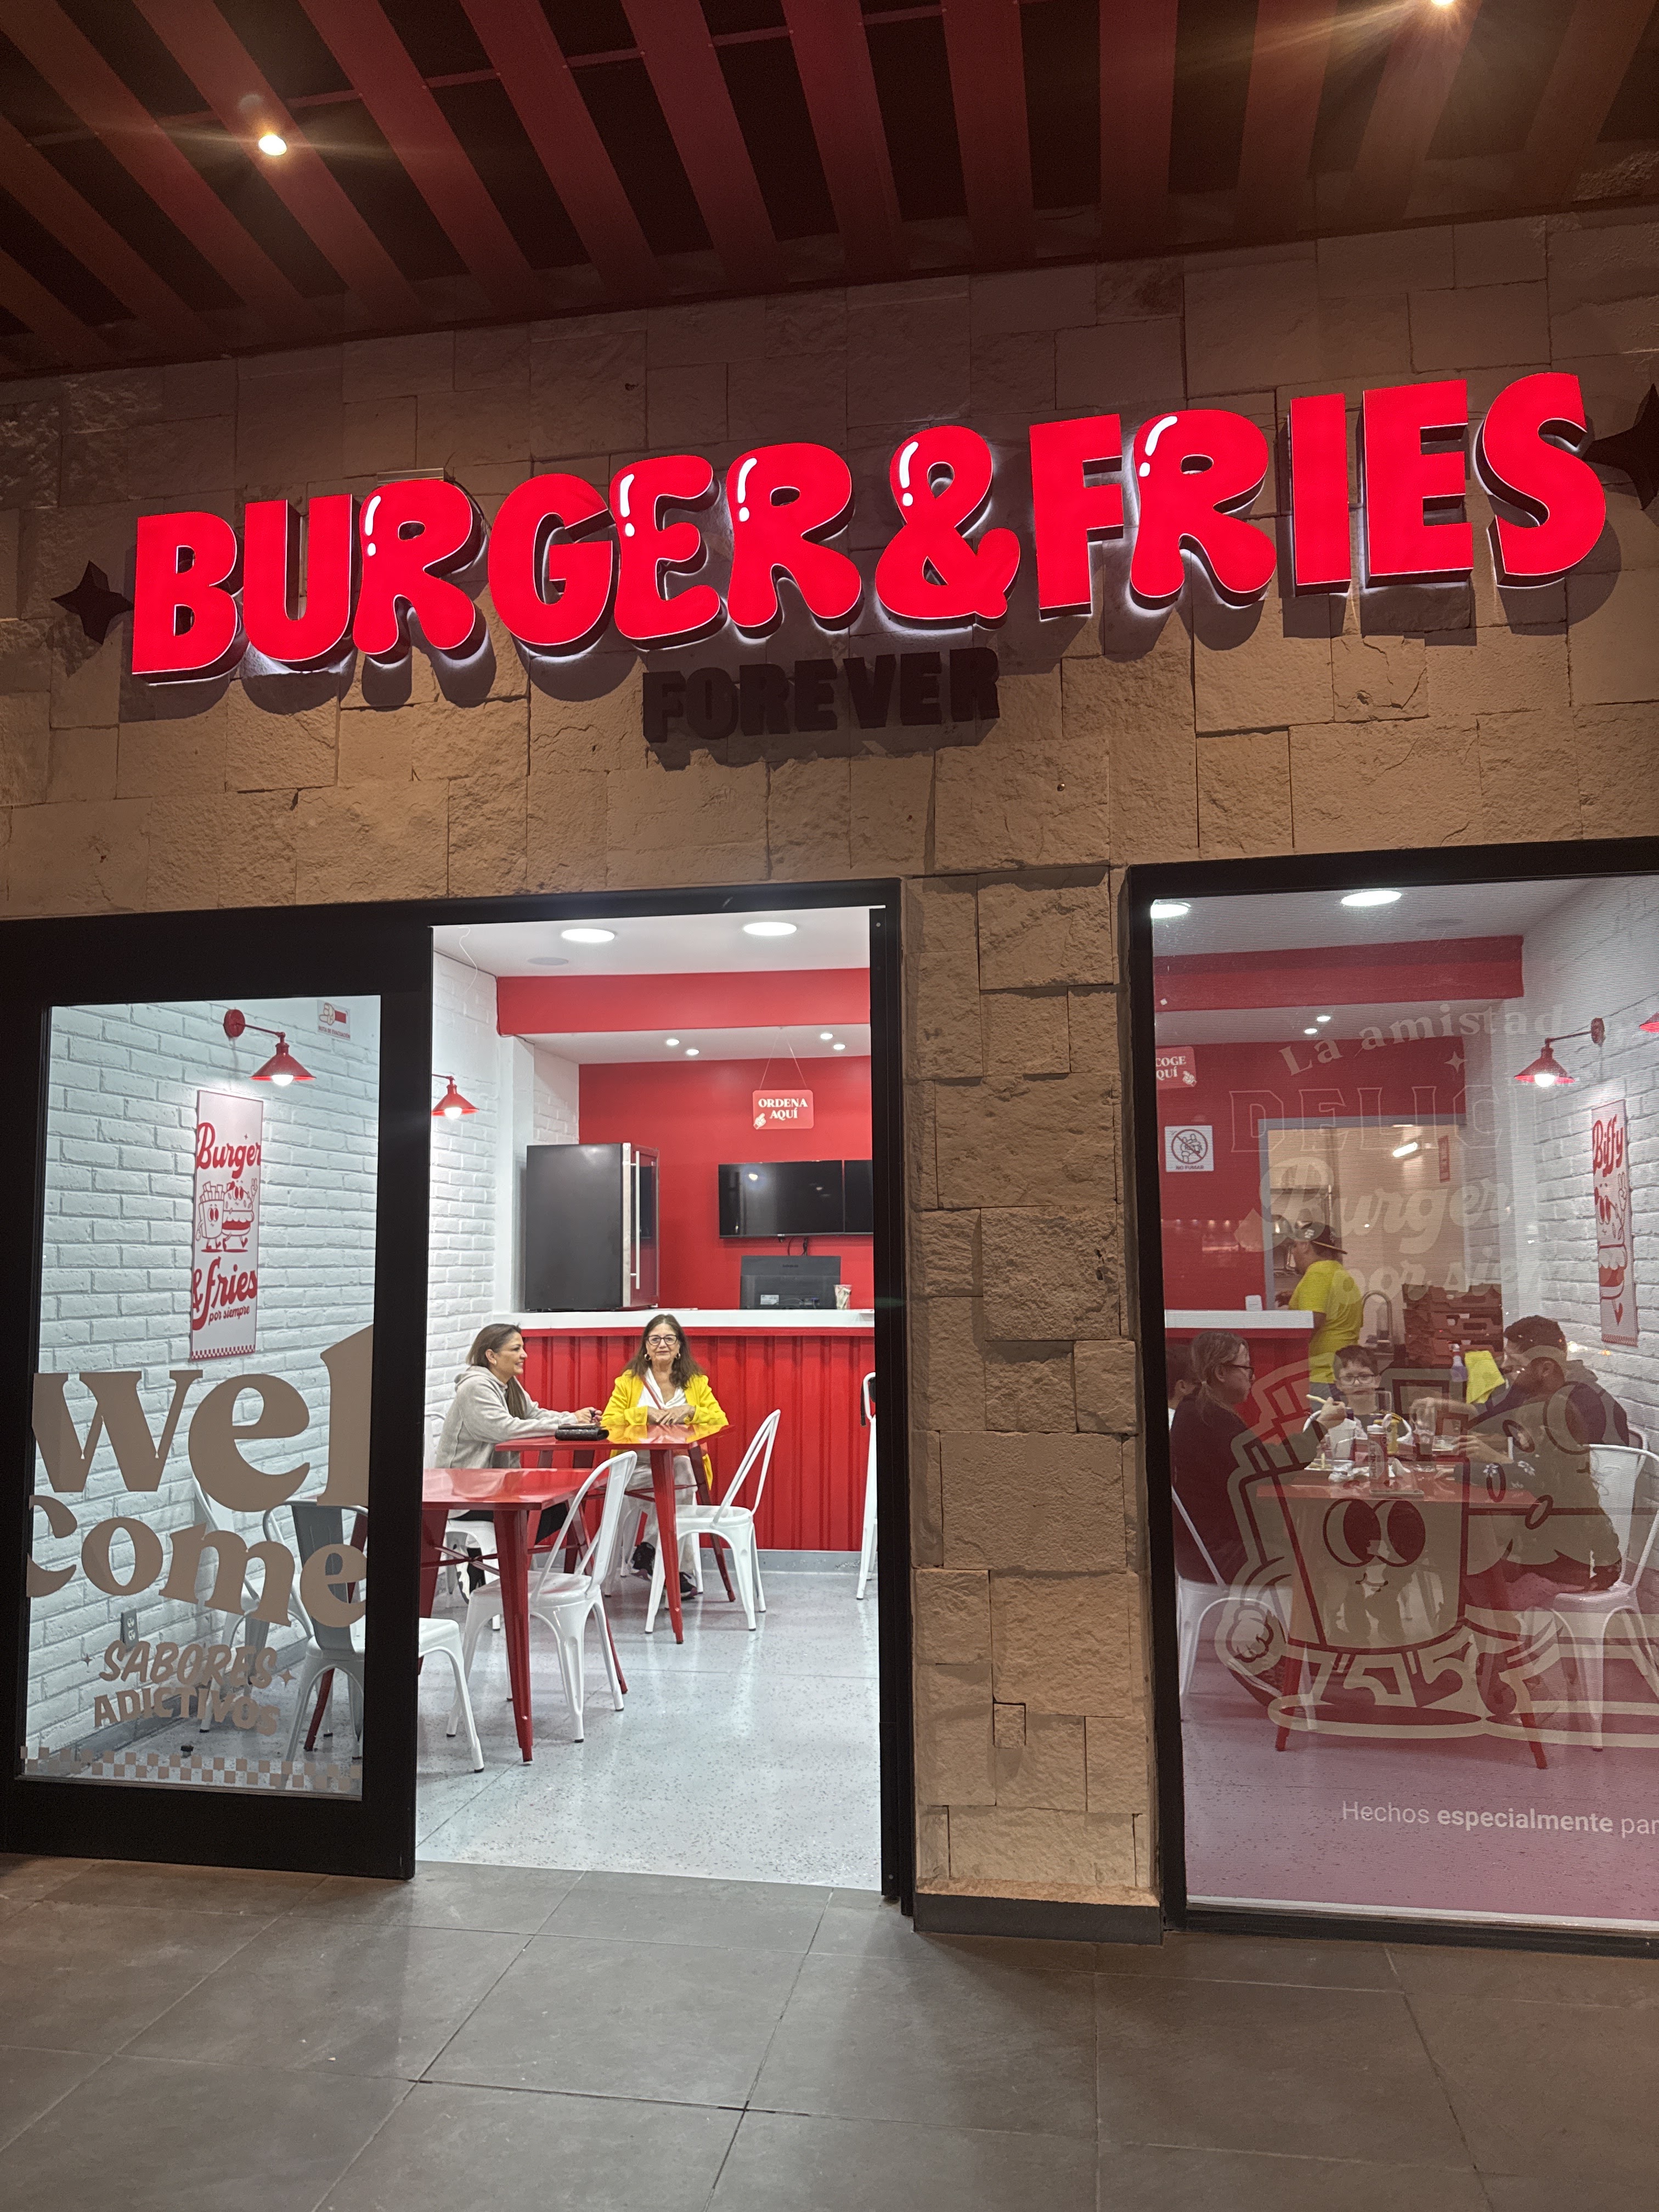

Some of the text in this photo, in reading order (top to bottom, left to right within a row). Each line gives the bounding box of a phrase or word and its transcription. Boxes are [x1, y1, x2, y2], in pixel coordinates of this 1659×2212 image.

[132, 442, 864, 681] BURGER
[1029, 373, 1606, 616] FRIES
[642, 647, 1000, 743] FOREVER
[1278, 1003, 1564, 1076] La amistad
[758, 1098, 808, 1108] ORDENA
[769, 1107, 798, 1121] AQUÍ
[196, 1122, 261, 1179] Burger
[1234, 1157, 1515, 1255] Burger
[208, 1306, 250, 1326] por siempre
[31, 1323, 374, 1512] wel
[98, 1639, 278, 1689] SABORES
[94, 1686, 281, 1736] ADICTIVOS
[1342, 1801, 1430, 1824] Hechos
[1437, 1808, 1613, 1833] especialmente
